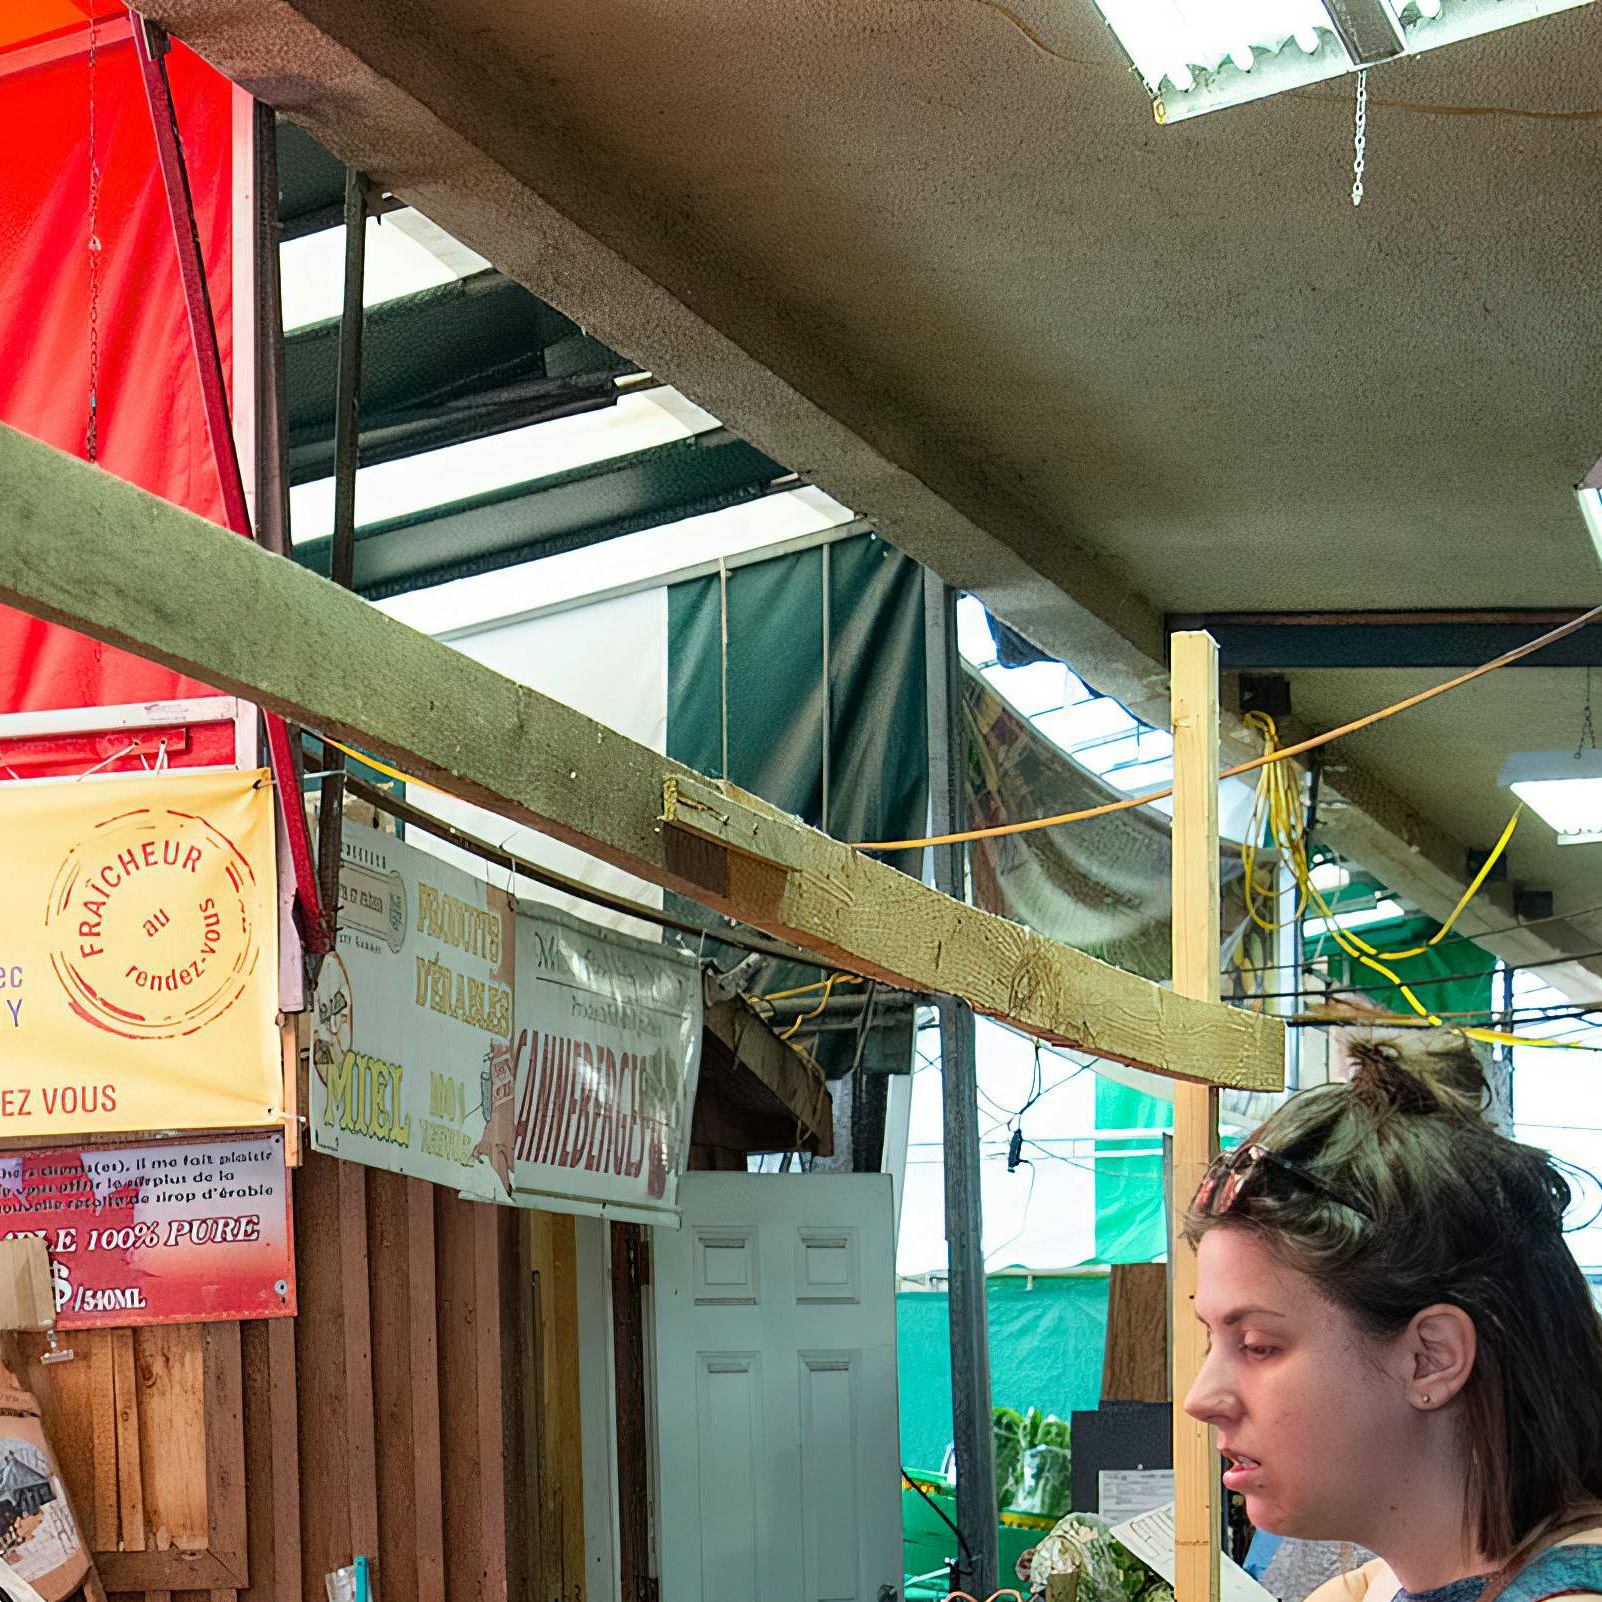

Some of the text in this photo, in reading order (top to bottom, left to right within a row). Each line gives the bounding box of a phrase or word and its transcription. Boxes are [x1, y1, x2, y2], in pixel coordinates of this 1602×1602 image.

[142, 908, 171, 938] au
[125, 898, 221, 992] rendez-vous
[42, 1084, 118, 1114] VOUS
[324, 1049, 412, 1149] MIEL
[87, 1221, 160, 1251] 100%
[164, 1215, 261, 1247] PURE
